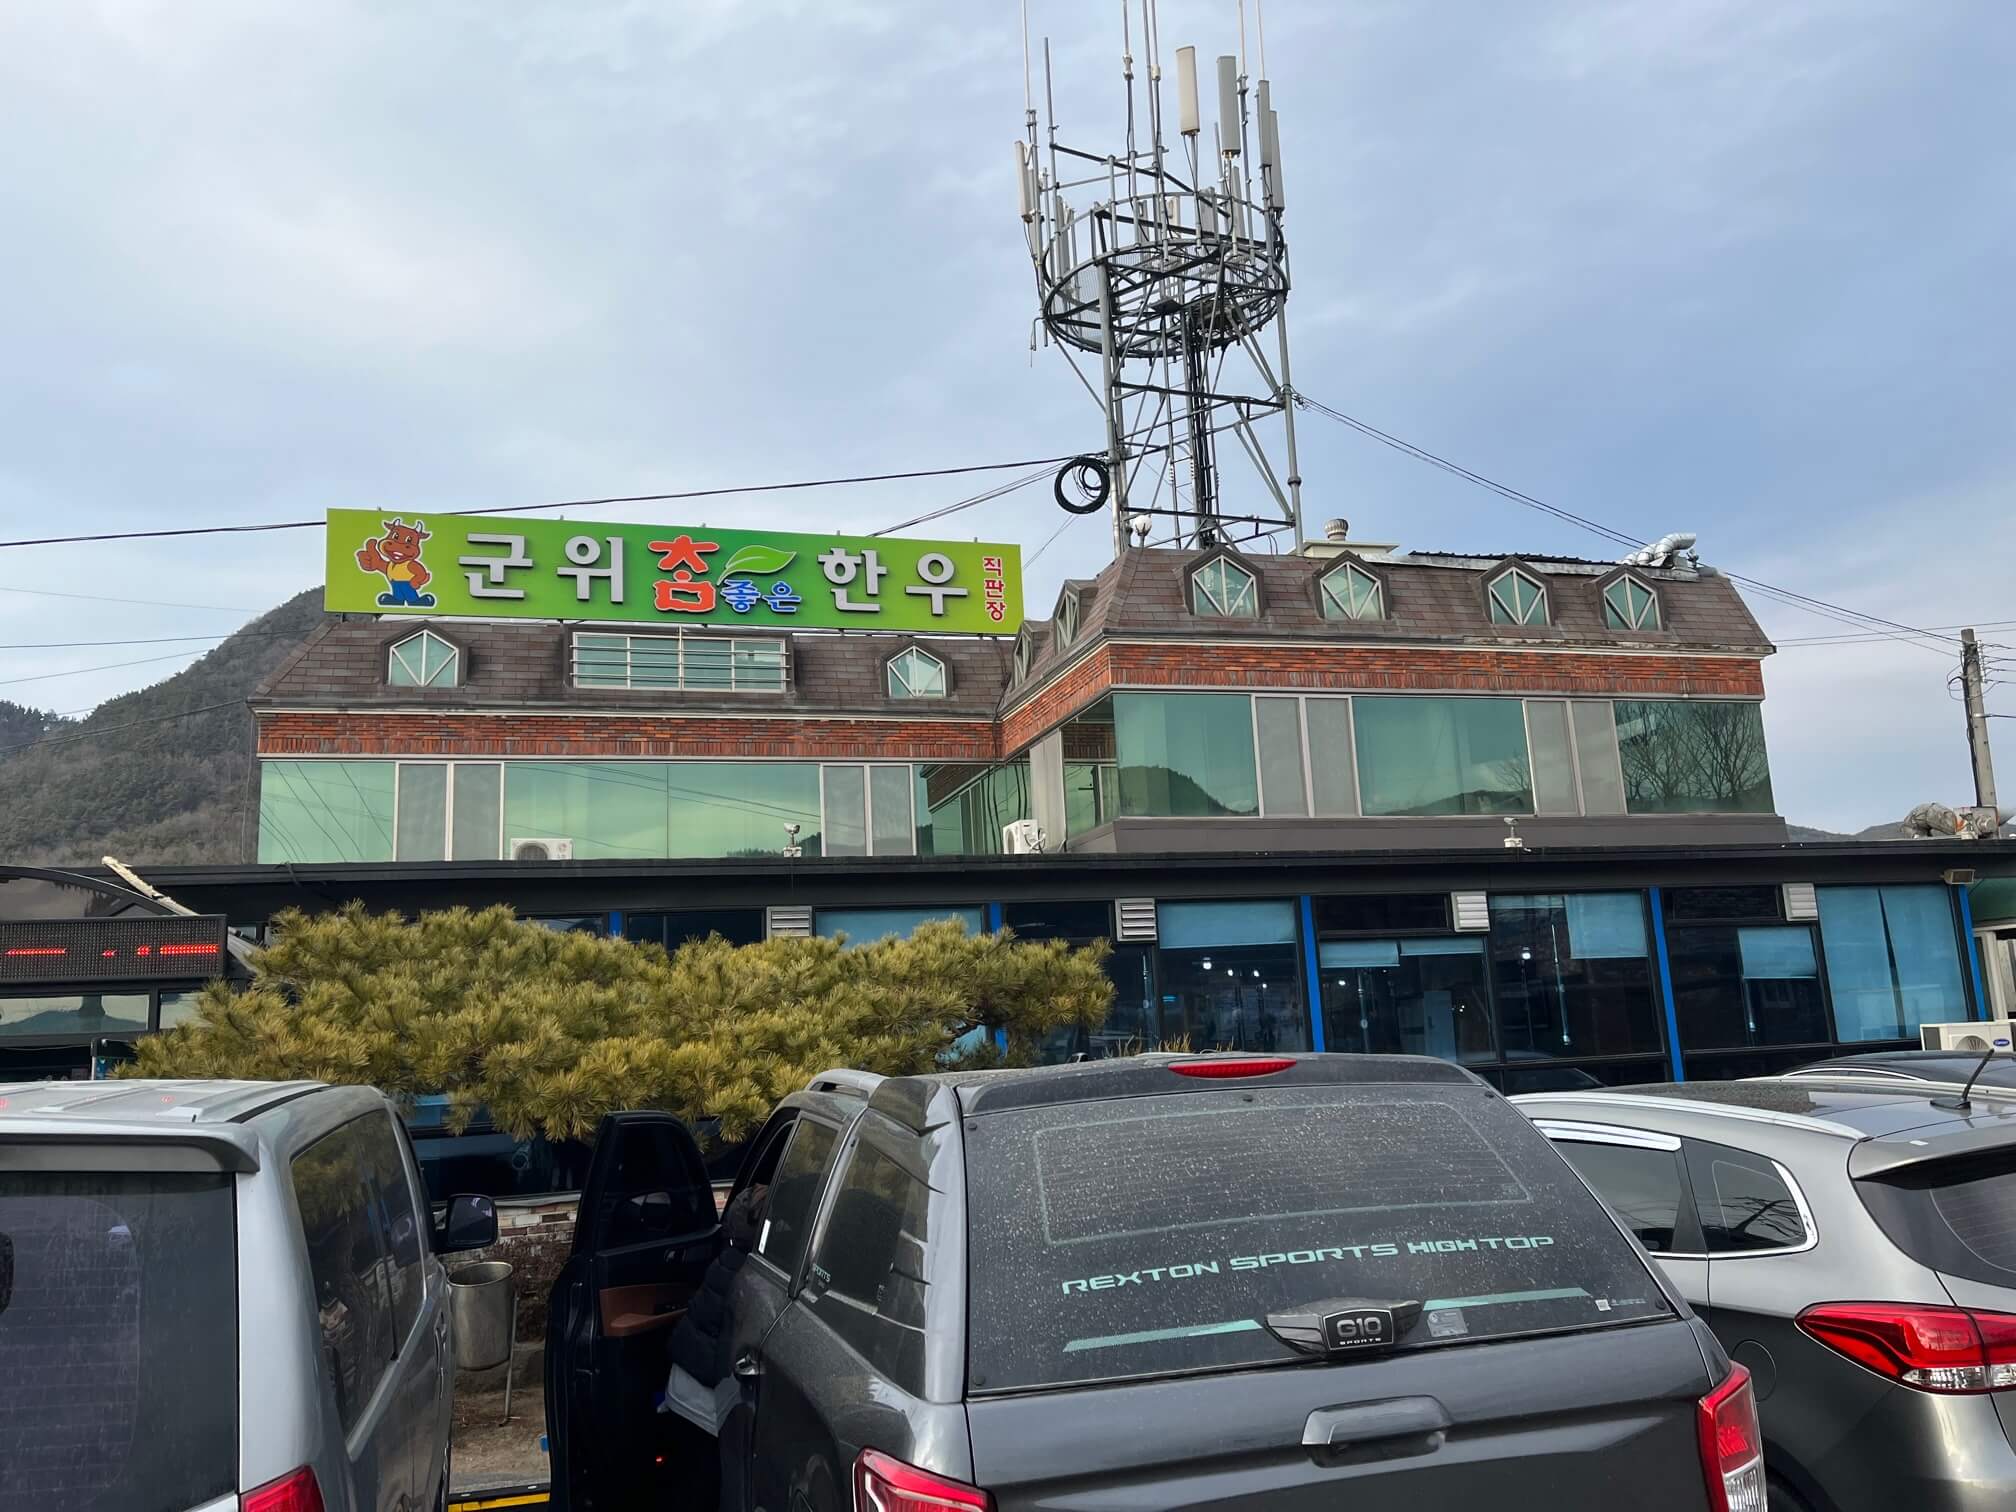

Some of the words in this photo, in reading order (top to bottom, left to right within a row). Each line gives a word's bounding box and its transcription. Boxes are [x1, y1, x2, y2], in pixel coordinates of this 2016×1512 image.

[459, 533, 624, 603] 군위
[720, 579, 803, 613] 좋은
[817, 547, 969, 616] 한우
[983, 556, 1006, 623] 직판장
[1062, 1261, 1220, 1295] REXTON
[1229, 1243, 1399, 1271] SPORTS
[1407, 1239, 1478, 1254] HIGH
[1479, 1236, 1554, 1249] TOP
[1336, 1317, 1382, 1337] G10
